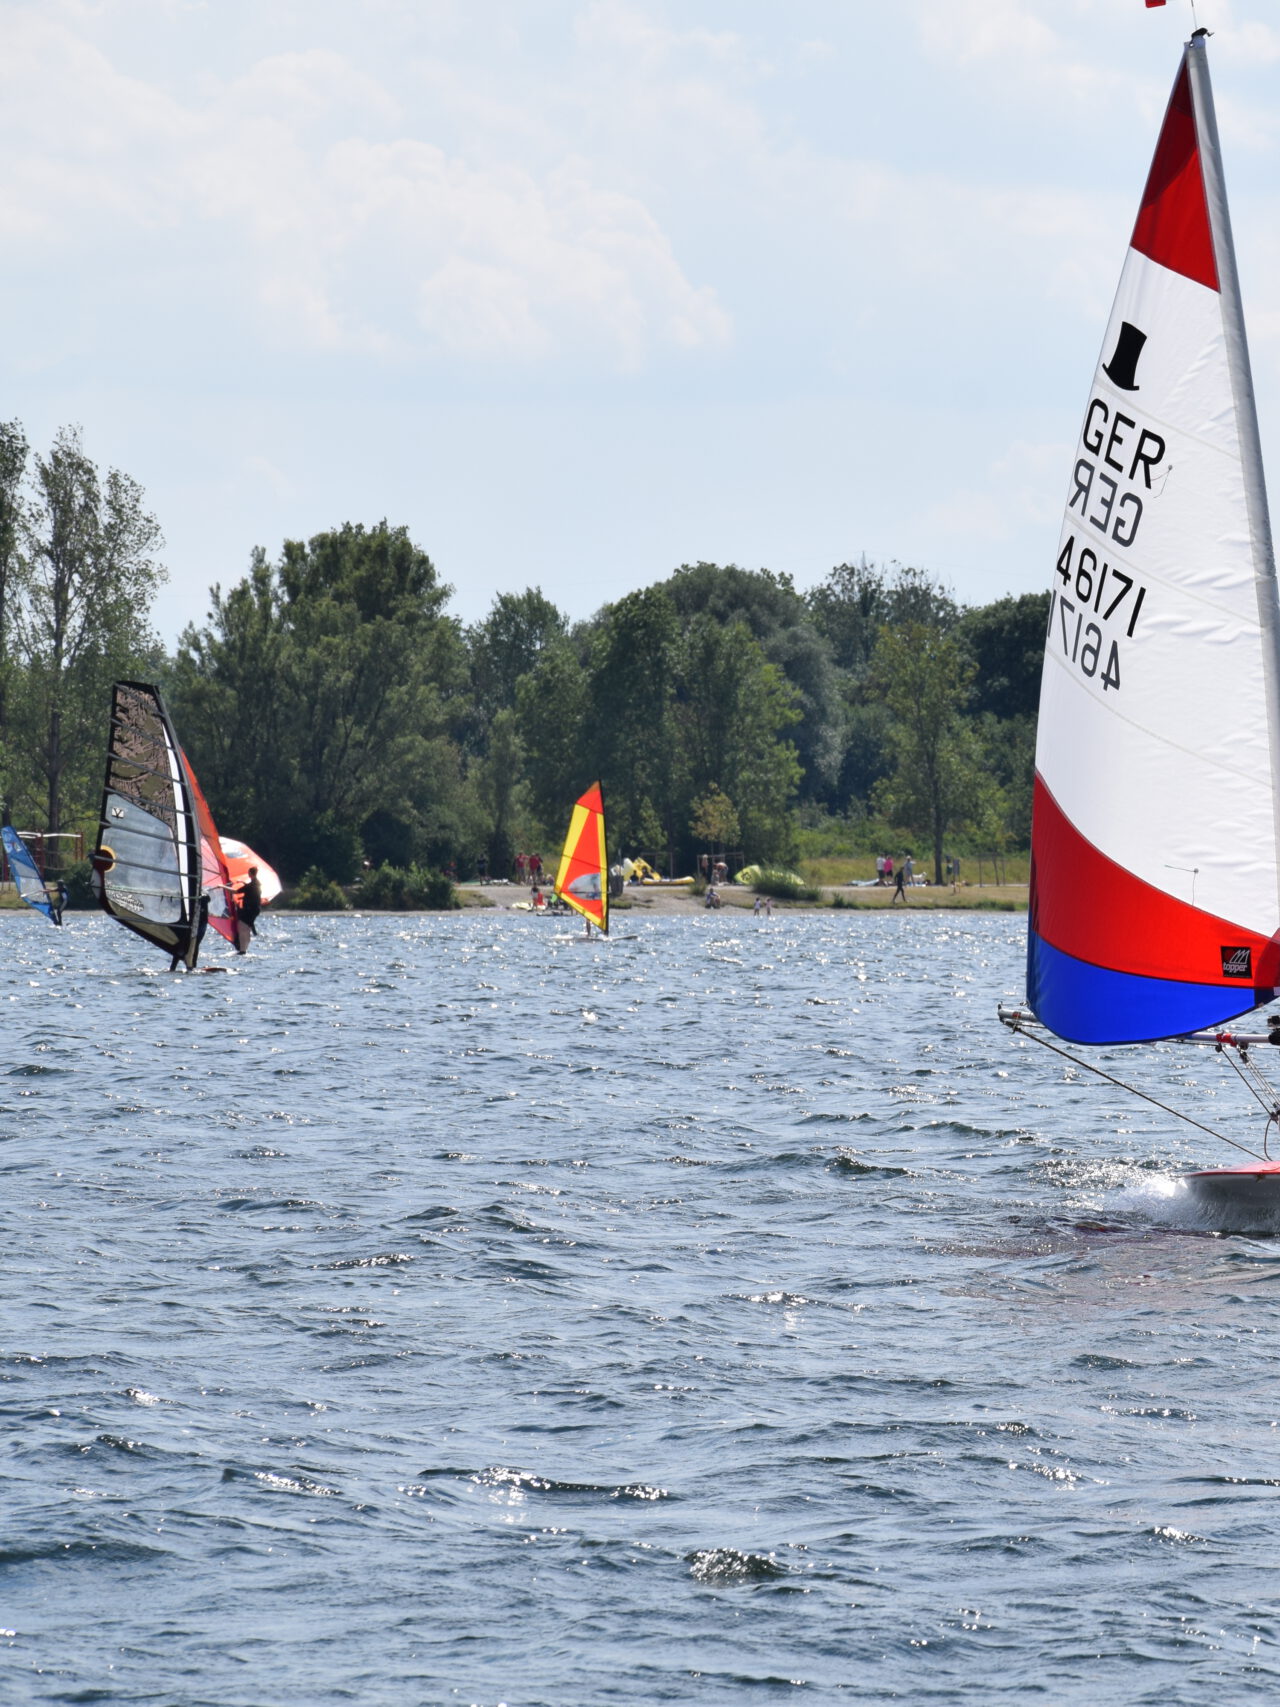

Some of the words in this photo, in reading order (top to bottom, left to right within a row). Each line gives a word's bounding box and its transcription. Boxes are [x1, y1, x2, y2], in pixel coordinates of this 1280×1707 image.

[1083, 397, 1166, 489] GER
[1056, 535, 1146, 638] 46171
[1222, 962, 1248, 973] topper
